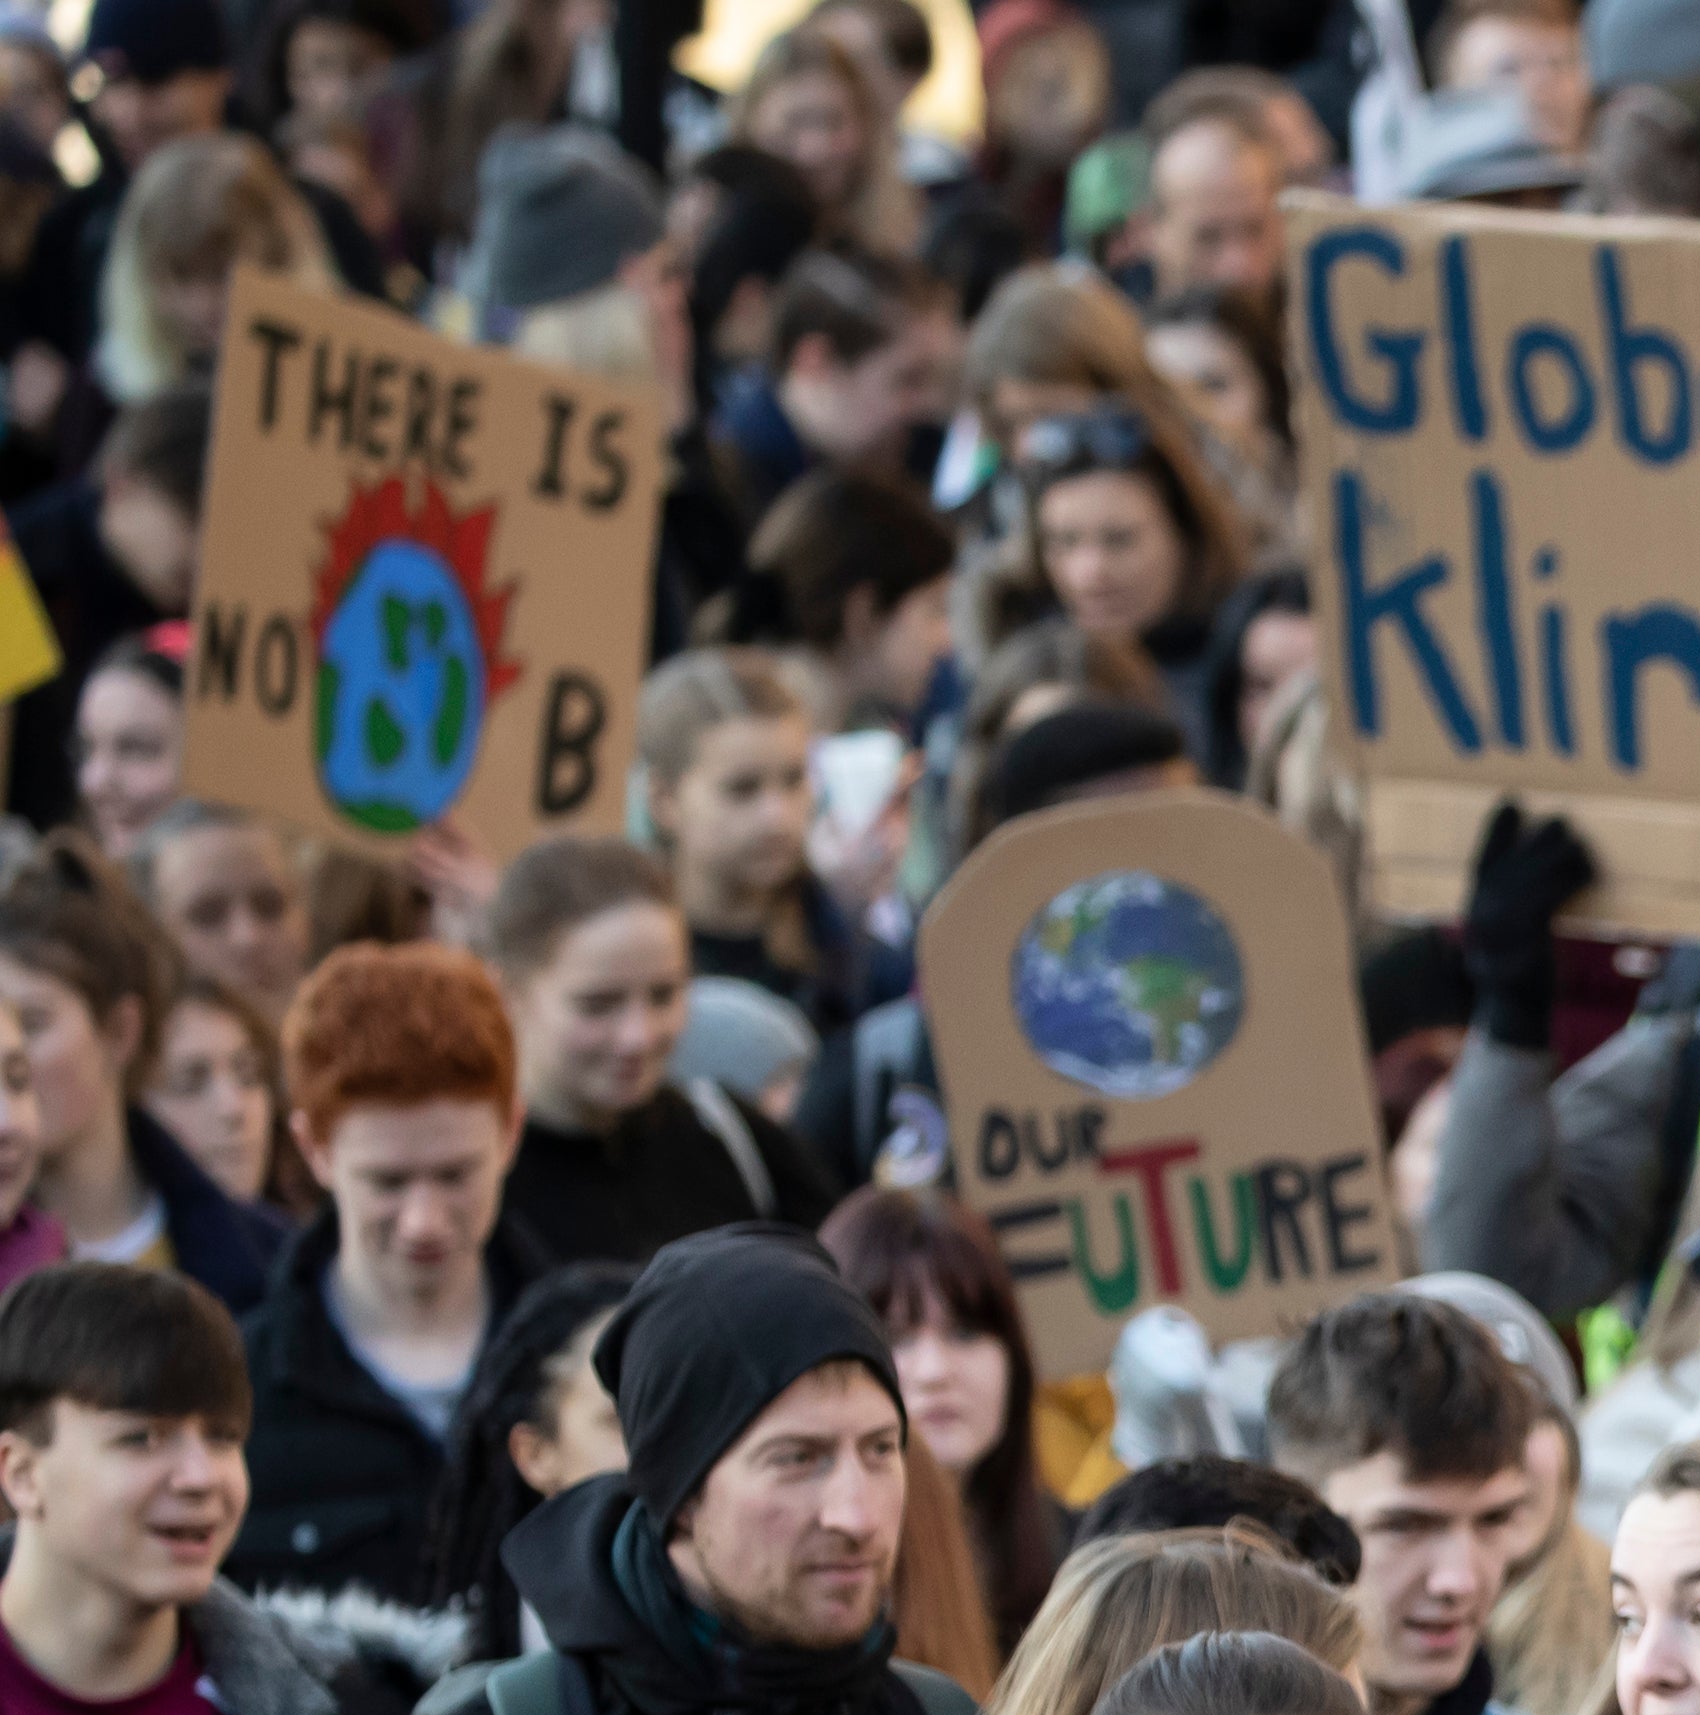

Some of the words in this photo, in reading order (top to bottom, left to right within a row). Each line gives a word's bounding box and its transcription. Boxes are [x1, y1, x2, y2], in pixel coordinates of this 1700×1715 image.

[250, 316, 482, 482] THERE
[535, 393, 628, 517] IS
[202, 601, 298, 718] NO
[536, 666, 606, 817] B
[978, 1105, 1105, 1180] OUR
